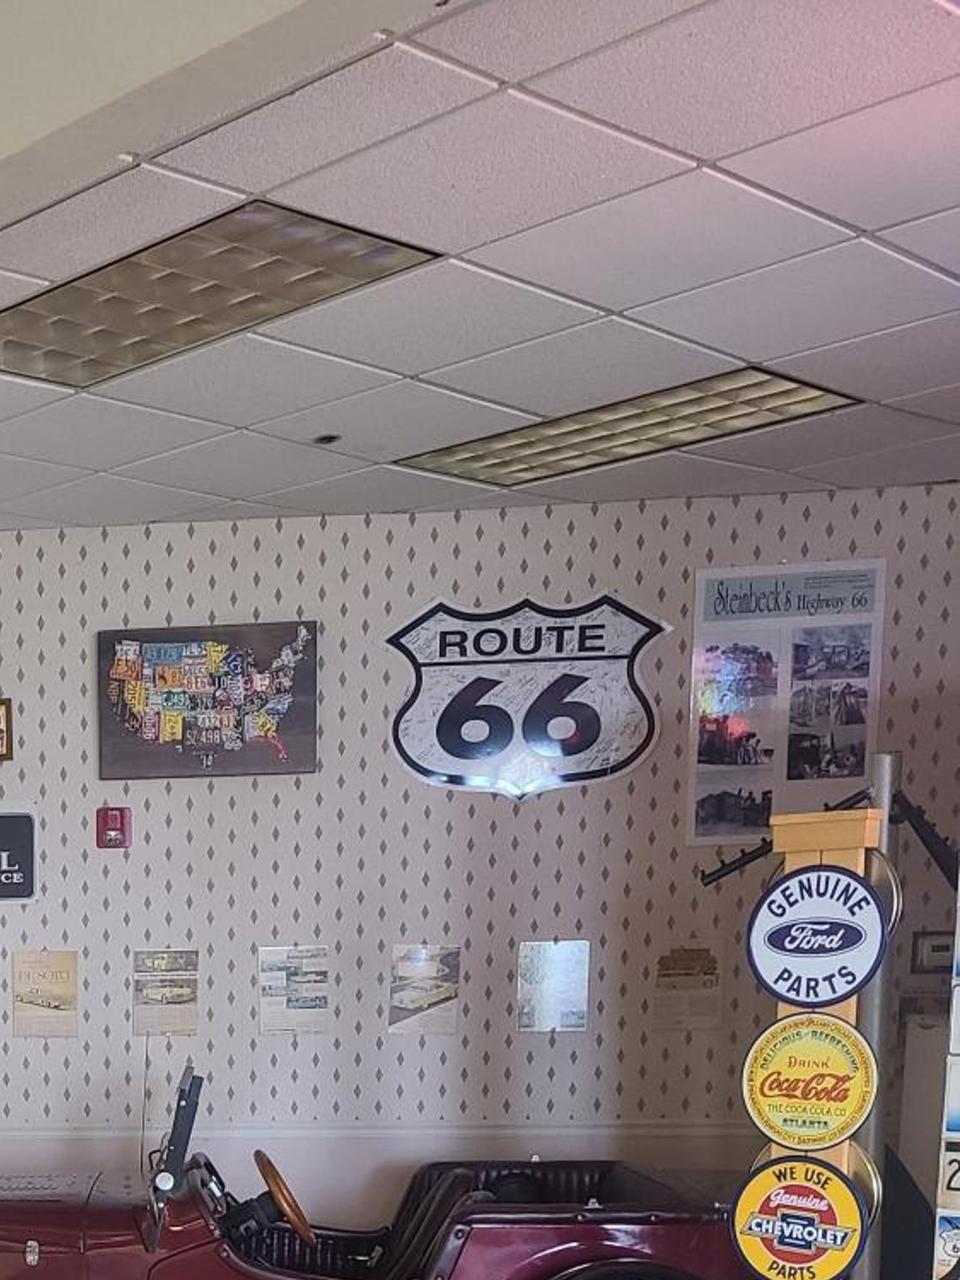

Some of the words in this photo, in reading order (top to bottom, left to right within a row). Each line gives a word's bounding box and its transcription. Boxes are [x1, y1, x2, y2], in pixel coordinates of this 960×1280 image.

[713, 579, 791, 616] Steinbeck's
[851, 591, 868, 609] 66
[439, 624, 606, 658] ROUTE
[436, 673, 601, 760] 66
[766, 874, 871, 918] GENUINE
[784, 924, 845, 950] Ford
[773, 965, 857, 998] PARTS
[767, 1103, 783, 1113] THE
[772, 1167, 797, 1182] WE
[804, 1167, 833, 1190] USE
[769, 1189, 829, 1211] Genuine
[751, 1218, 845, 1245] CHEVROLET
[767, 1260, 816, 1280] PARTS
